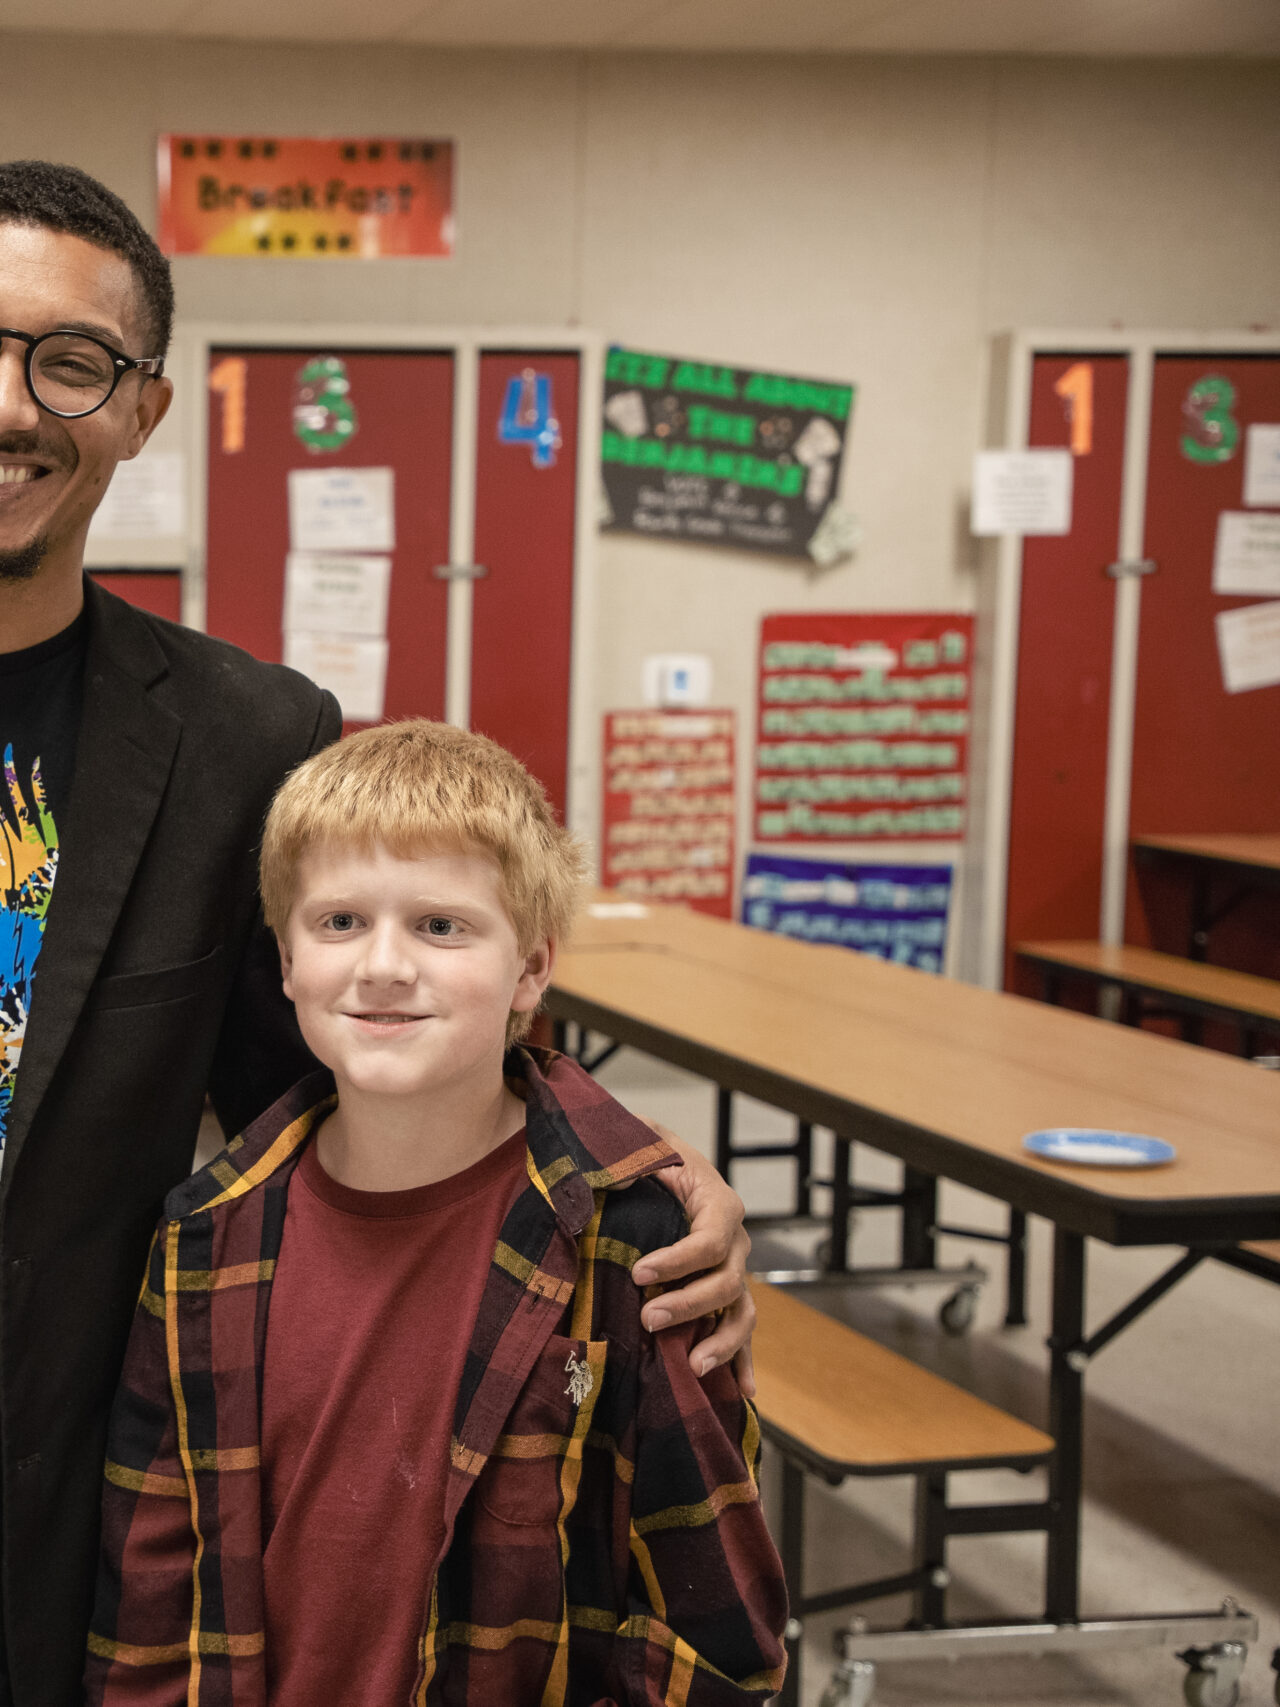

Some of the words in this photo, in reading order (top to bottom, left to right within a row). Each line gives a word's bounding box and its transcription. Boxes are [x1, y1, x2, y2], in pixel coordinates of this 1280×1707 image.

[197, 175, 413, 214] Breakfast
[209, 356, 247, 453] 1
[498, 371, 558, 468] 4
[687, 404, 756, 447] THE
[1055, 361, 1094, 457] 1
[1181, 373, 1239, 465] 3
